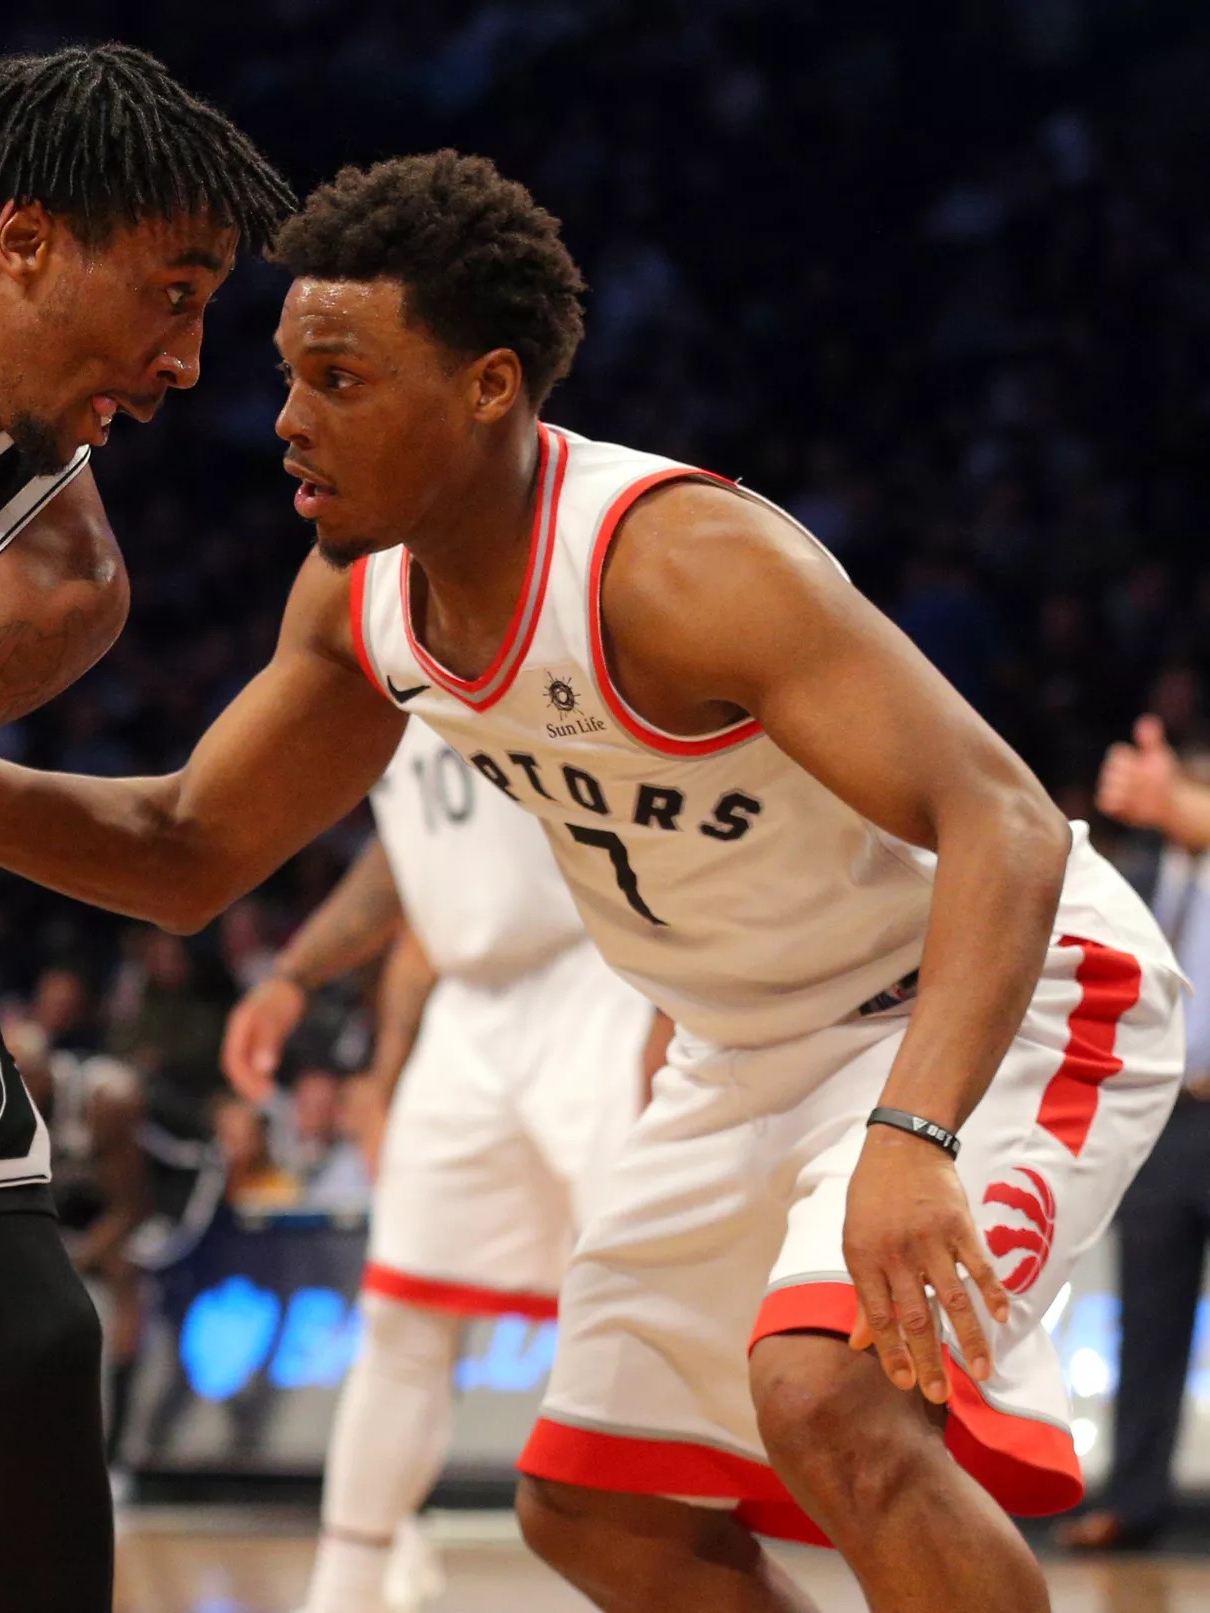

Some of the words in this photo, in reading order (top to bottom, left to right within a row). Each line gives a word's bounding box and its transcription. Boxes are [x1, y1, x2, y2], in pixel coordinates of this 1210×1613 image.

[546, 723, 577, 738] Sun
[576, 717, 607, 733] Life
[411, 745, 476, 835] 10
[565, 822, 671, 927] 7
